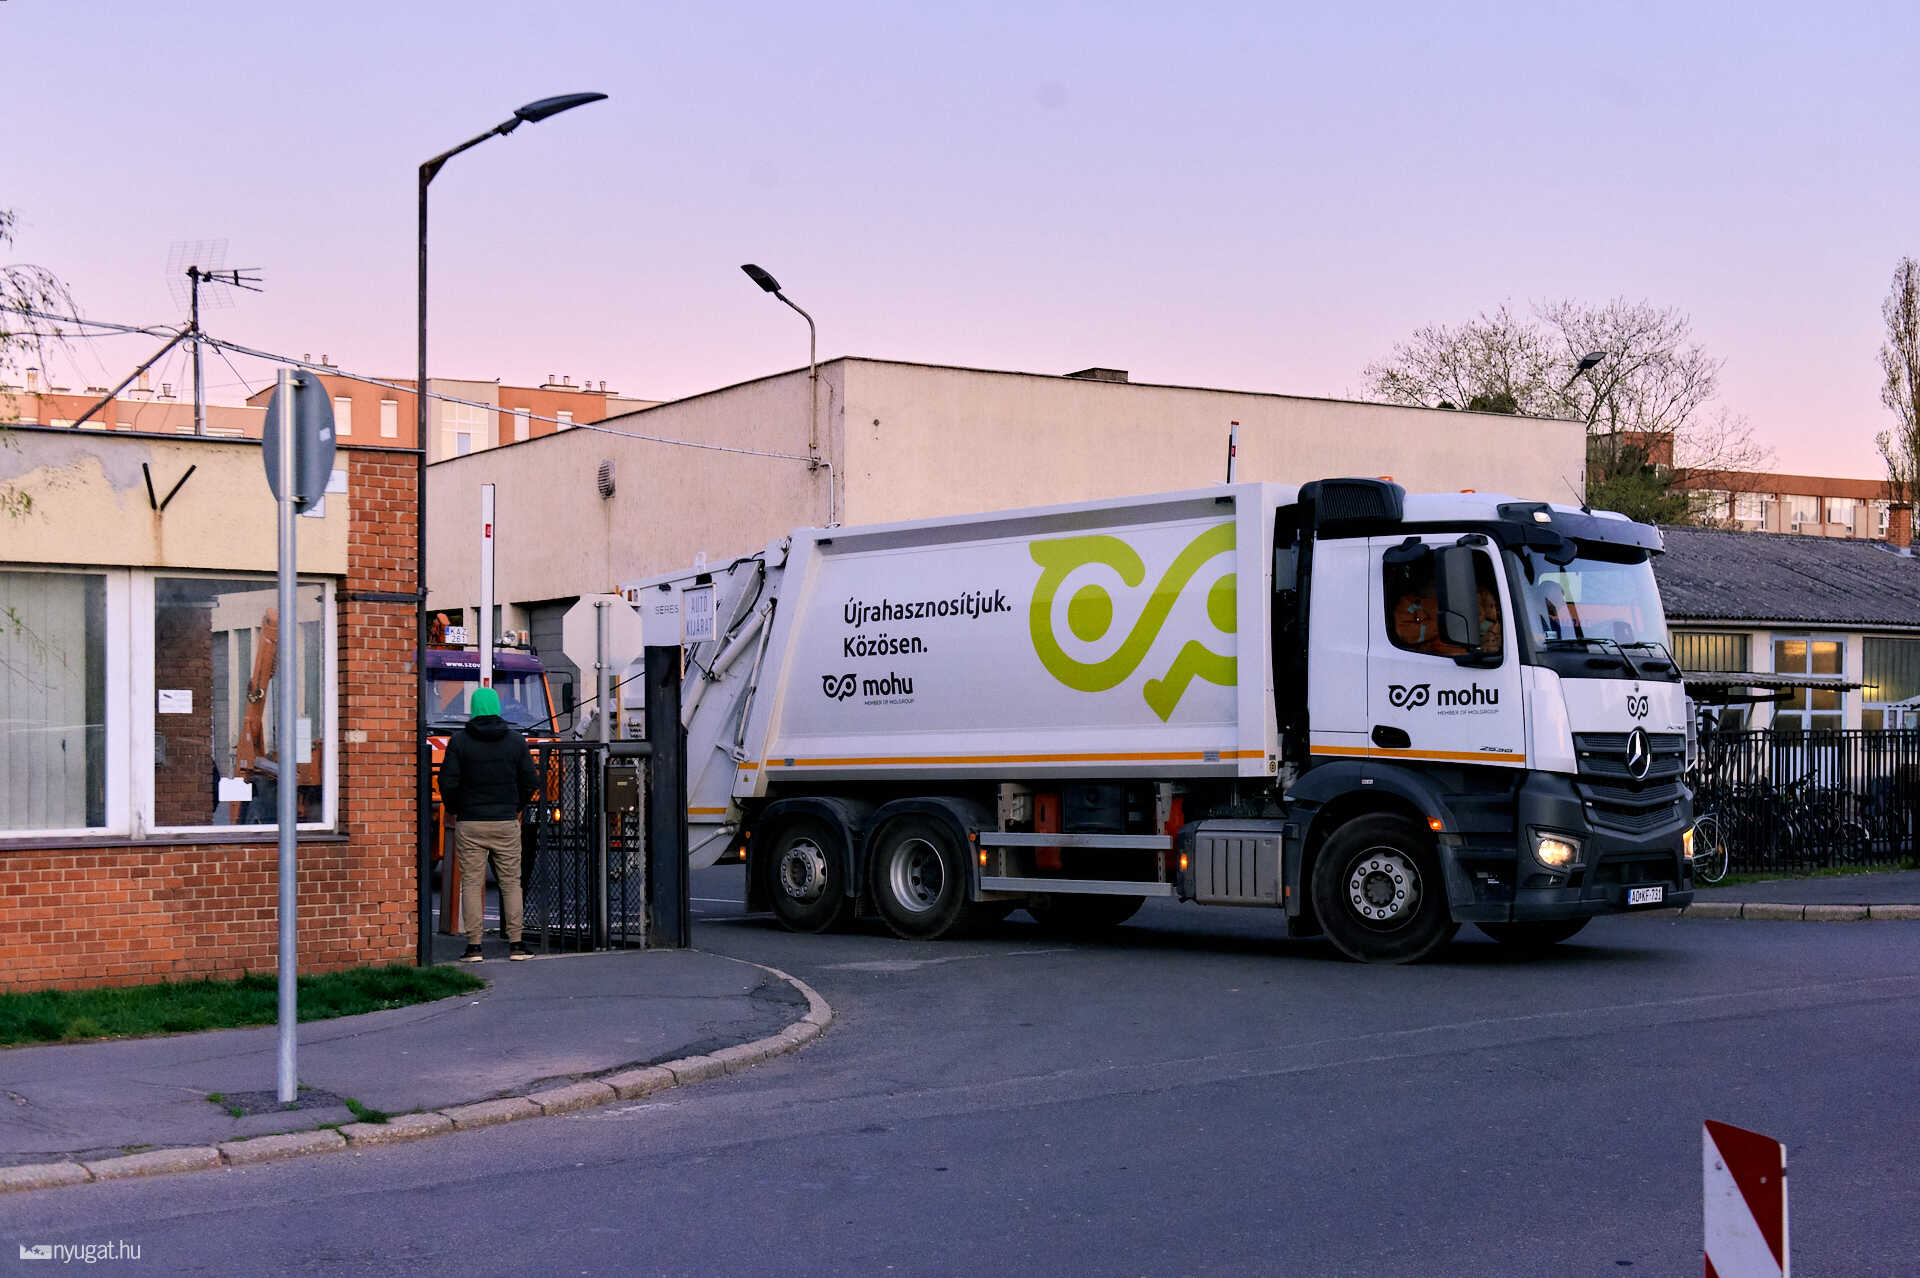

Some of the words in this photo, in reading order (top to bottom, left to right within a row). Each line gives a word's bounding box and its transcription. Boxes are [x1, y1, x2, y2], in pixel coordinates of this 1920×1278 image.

[844, 589, 1012, 628] Újrahasznosítjuk.
[844, 633, 928, 658] Közösen.
[862, 671, 913, 696] mohu
[1437, 682, 1499, 706] mohu
